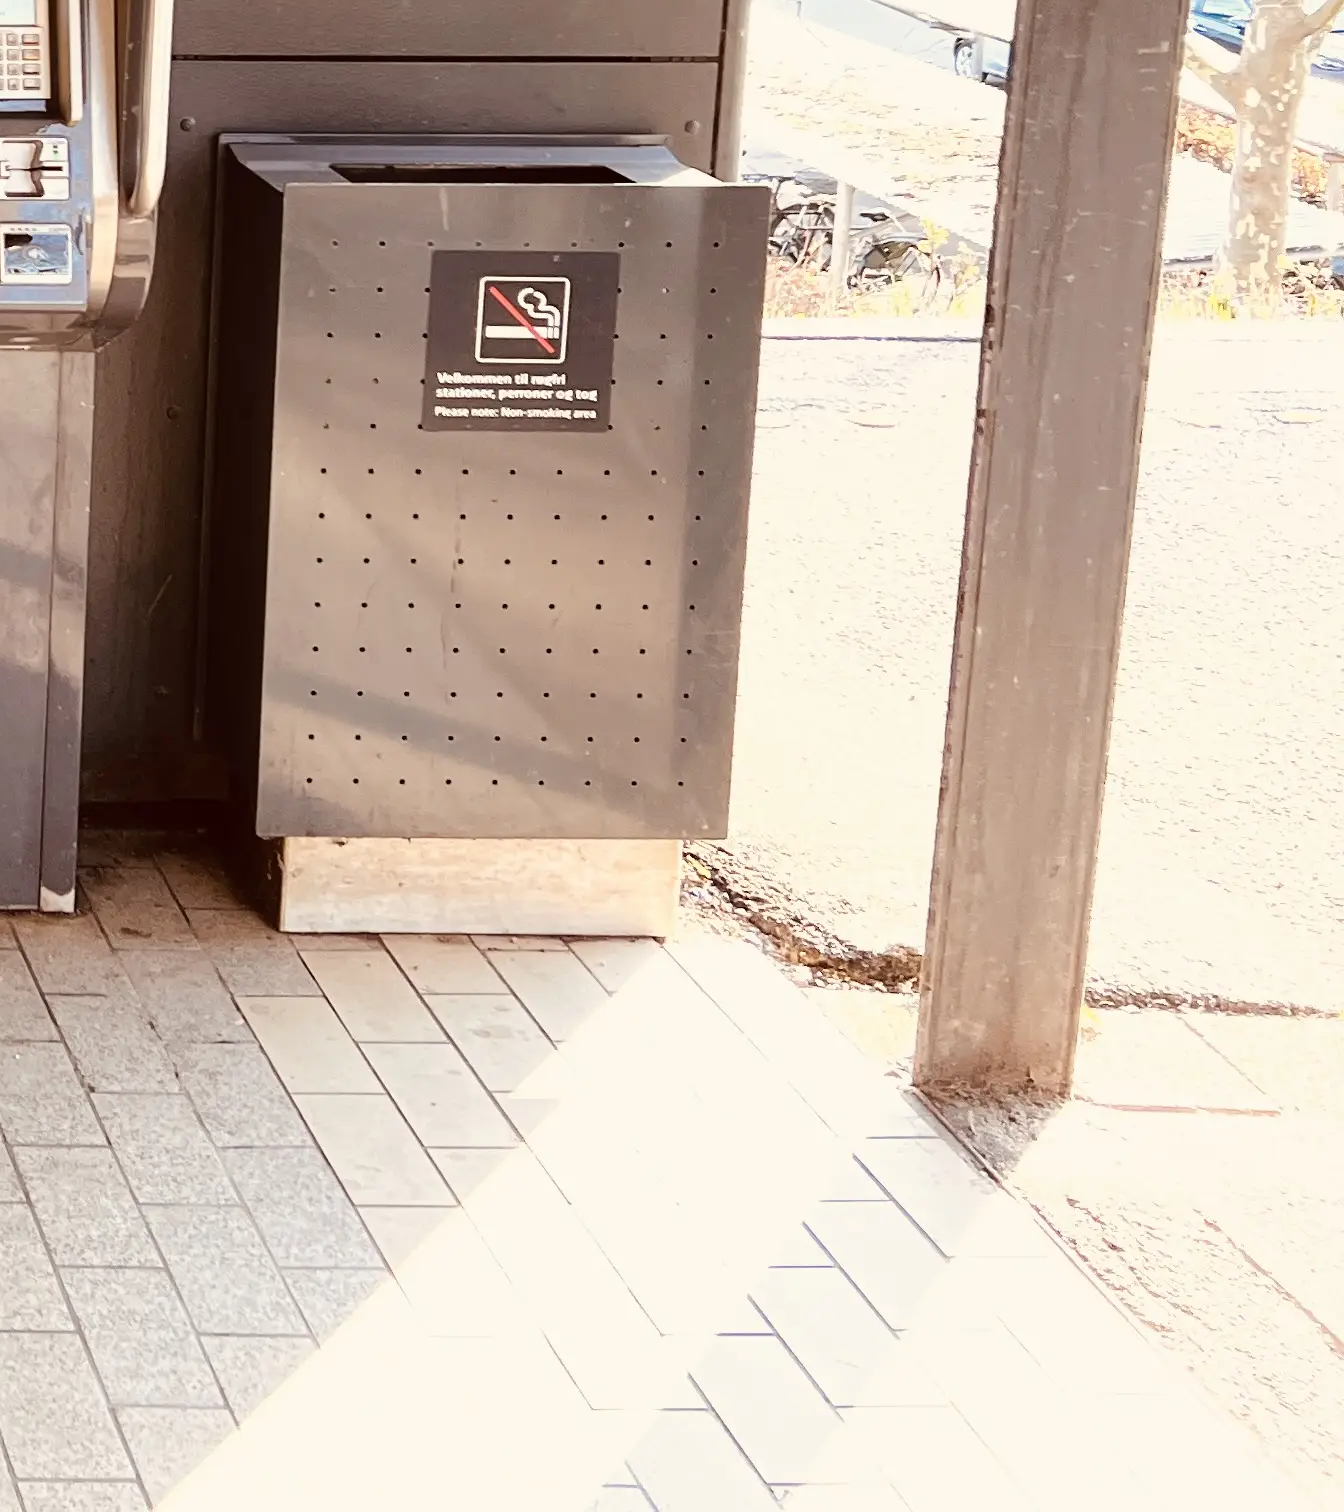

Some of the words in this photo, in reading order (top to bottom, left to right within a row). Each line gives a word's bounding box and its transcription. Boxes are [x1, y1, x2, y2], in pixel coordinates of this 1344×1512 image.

[436, 372, 513, 385] Velkommen
[514, 373, 529, 385] til
[498, 389, 554, 402] perroner
[555, 390, 574, 402] og
[575, 389, 598, 402] tog
[434, 406, 470, 418] Please
[500, 407, 572, 420] Non-smoking
[573, 409, 597, 419] area
